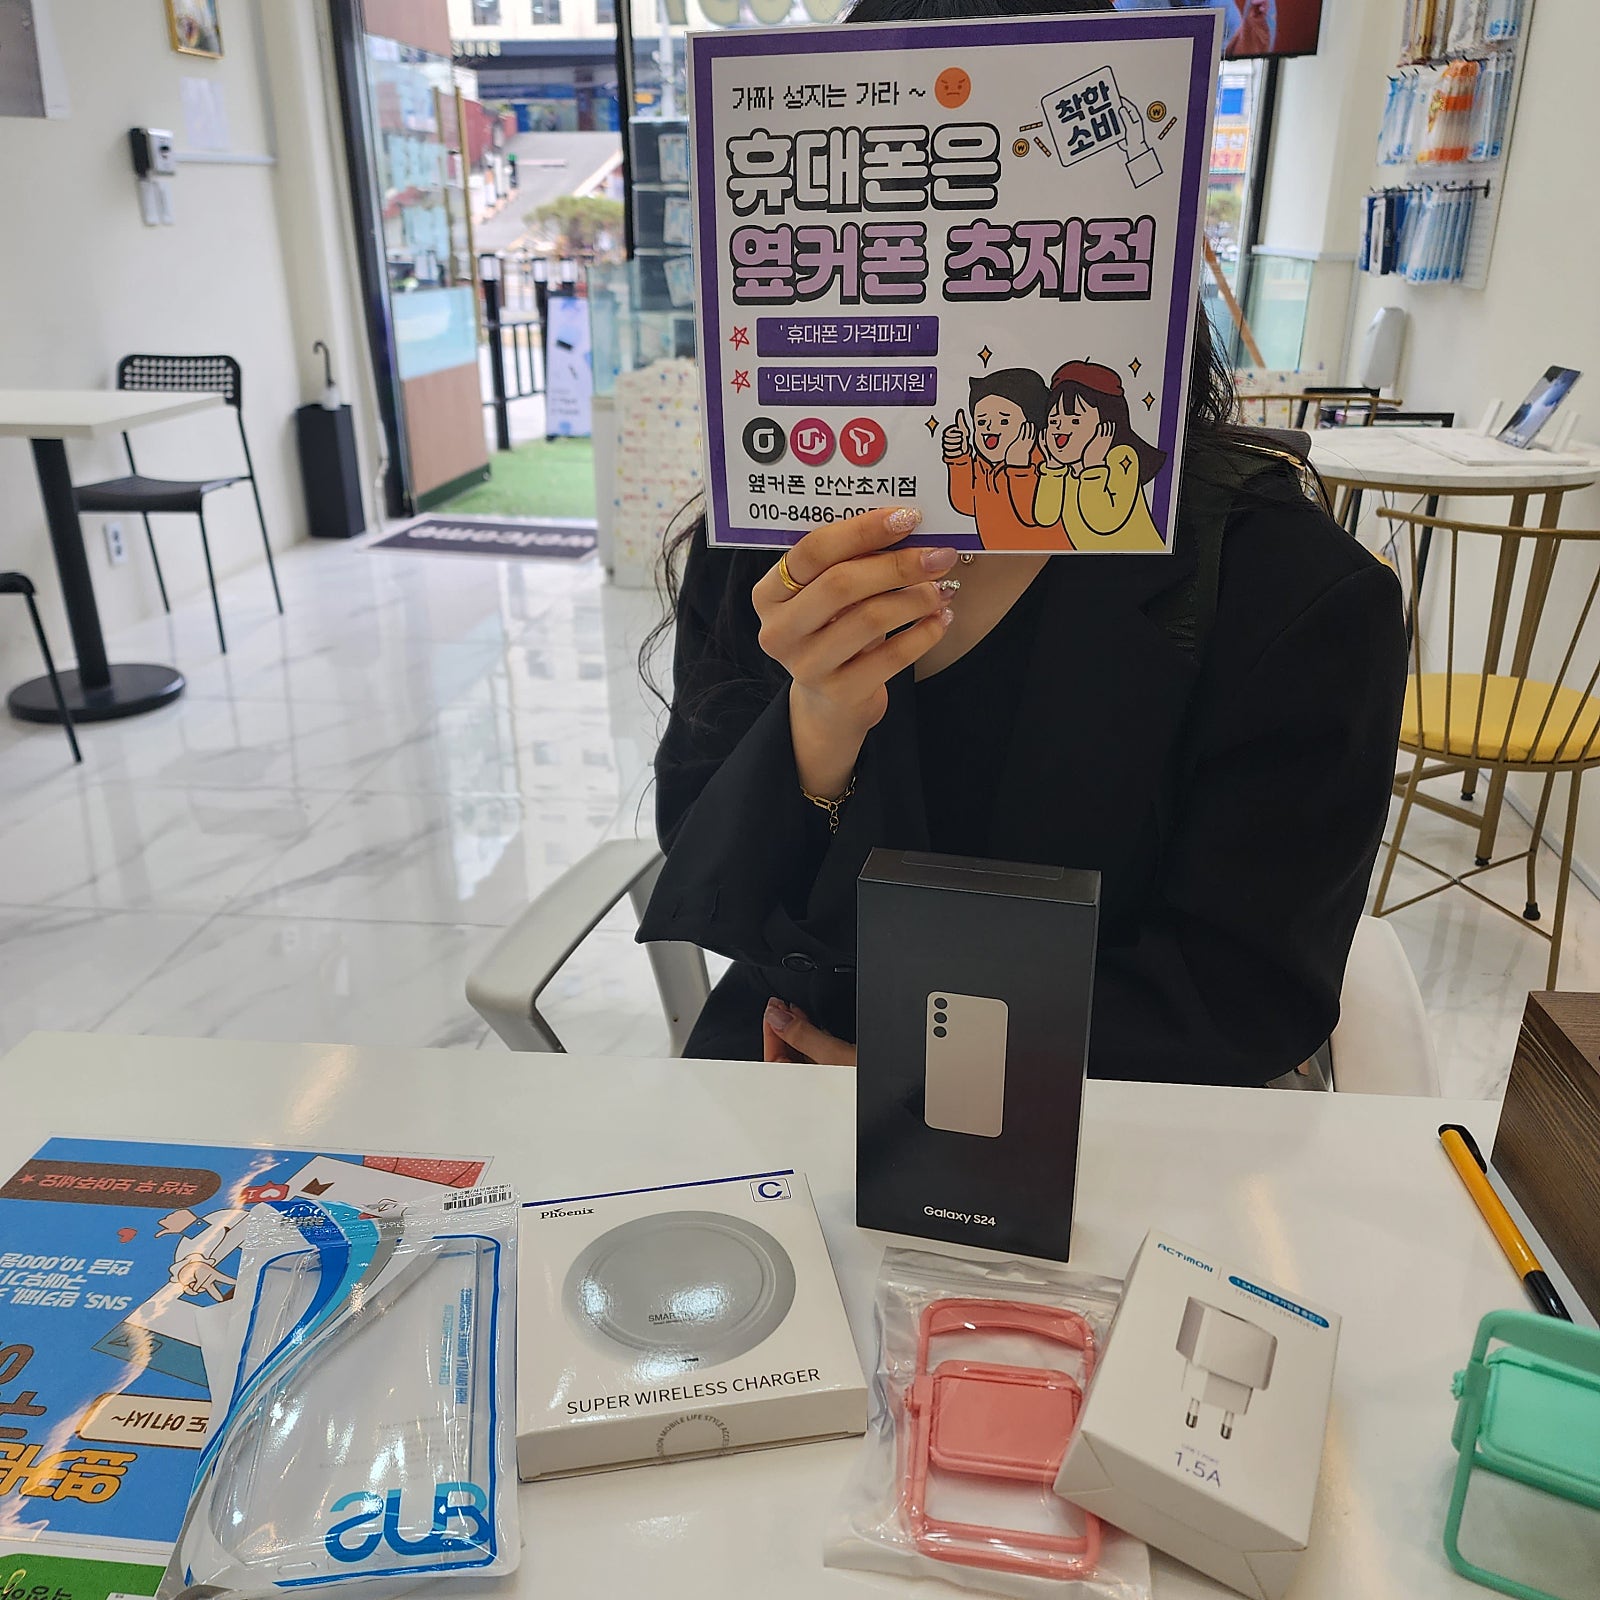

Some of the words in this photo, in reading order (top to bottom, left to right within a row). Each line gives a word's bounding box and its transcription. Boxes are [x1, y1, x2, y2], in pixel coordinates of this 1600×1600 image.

[732, 85, 775, 111] 가짜
[783, 83, 847, 110] 성지는
[856, 81, 900, 106] 가라
[1055, 80, 1112, 124] 착한
[1067, 107, 1122, 156] 소비
[726, 122, 1001, 217] 휴대폰은
[730, 221, 928, 305] 옆커폰
[943, 215, 1157, 302] 초지점
[787, 324, 839, 344] 휴대폰
[774, 373, 852, 392] 인터넷TV
[855, 373, 925, 392] 최대지원
[748, 473, 806, 496] 옆커폰
[814, 475, 917, 498] 안산초지점
[38, 1173, 136, 1193] 보여주세요
[134, 1180, 158, 1193] 후
[157, 1180, 199, 1197] 작성
[757, 1181, 783, 1199] C
[540, 1207, 595, 1220] Phoenix
[923, 1205, 972, 1225] Galaxy
[973, 1213, 997, 1227] S24
[87, 1258, 134, 1276] 현금
[9, 1286, 80, 1308] 맘카페,
[84, 1292, 132, 1311] SNS,
[567, 1393, 630, 1415] SUPER
[634, 1380, 728, 1405] WIRELESS
[732, 1367, 821, 1393] CHARGER
[111, 1409, 186, 1431] 여기서~
[659, 1416, 685, 1438] MOBILE
[0, 1442, 138, 1504] 옆커
[1175, 1451, 1221, 1488] 1.5A
